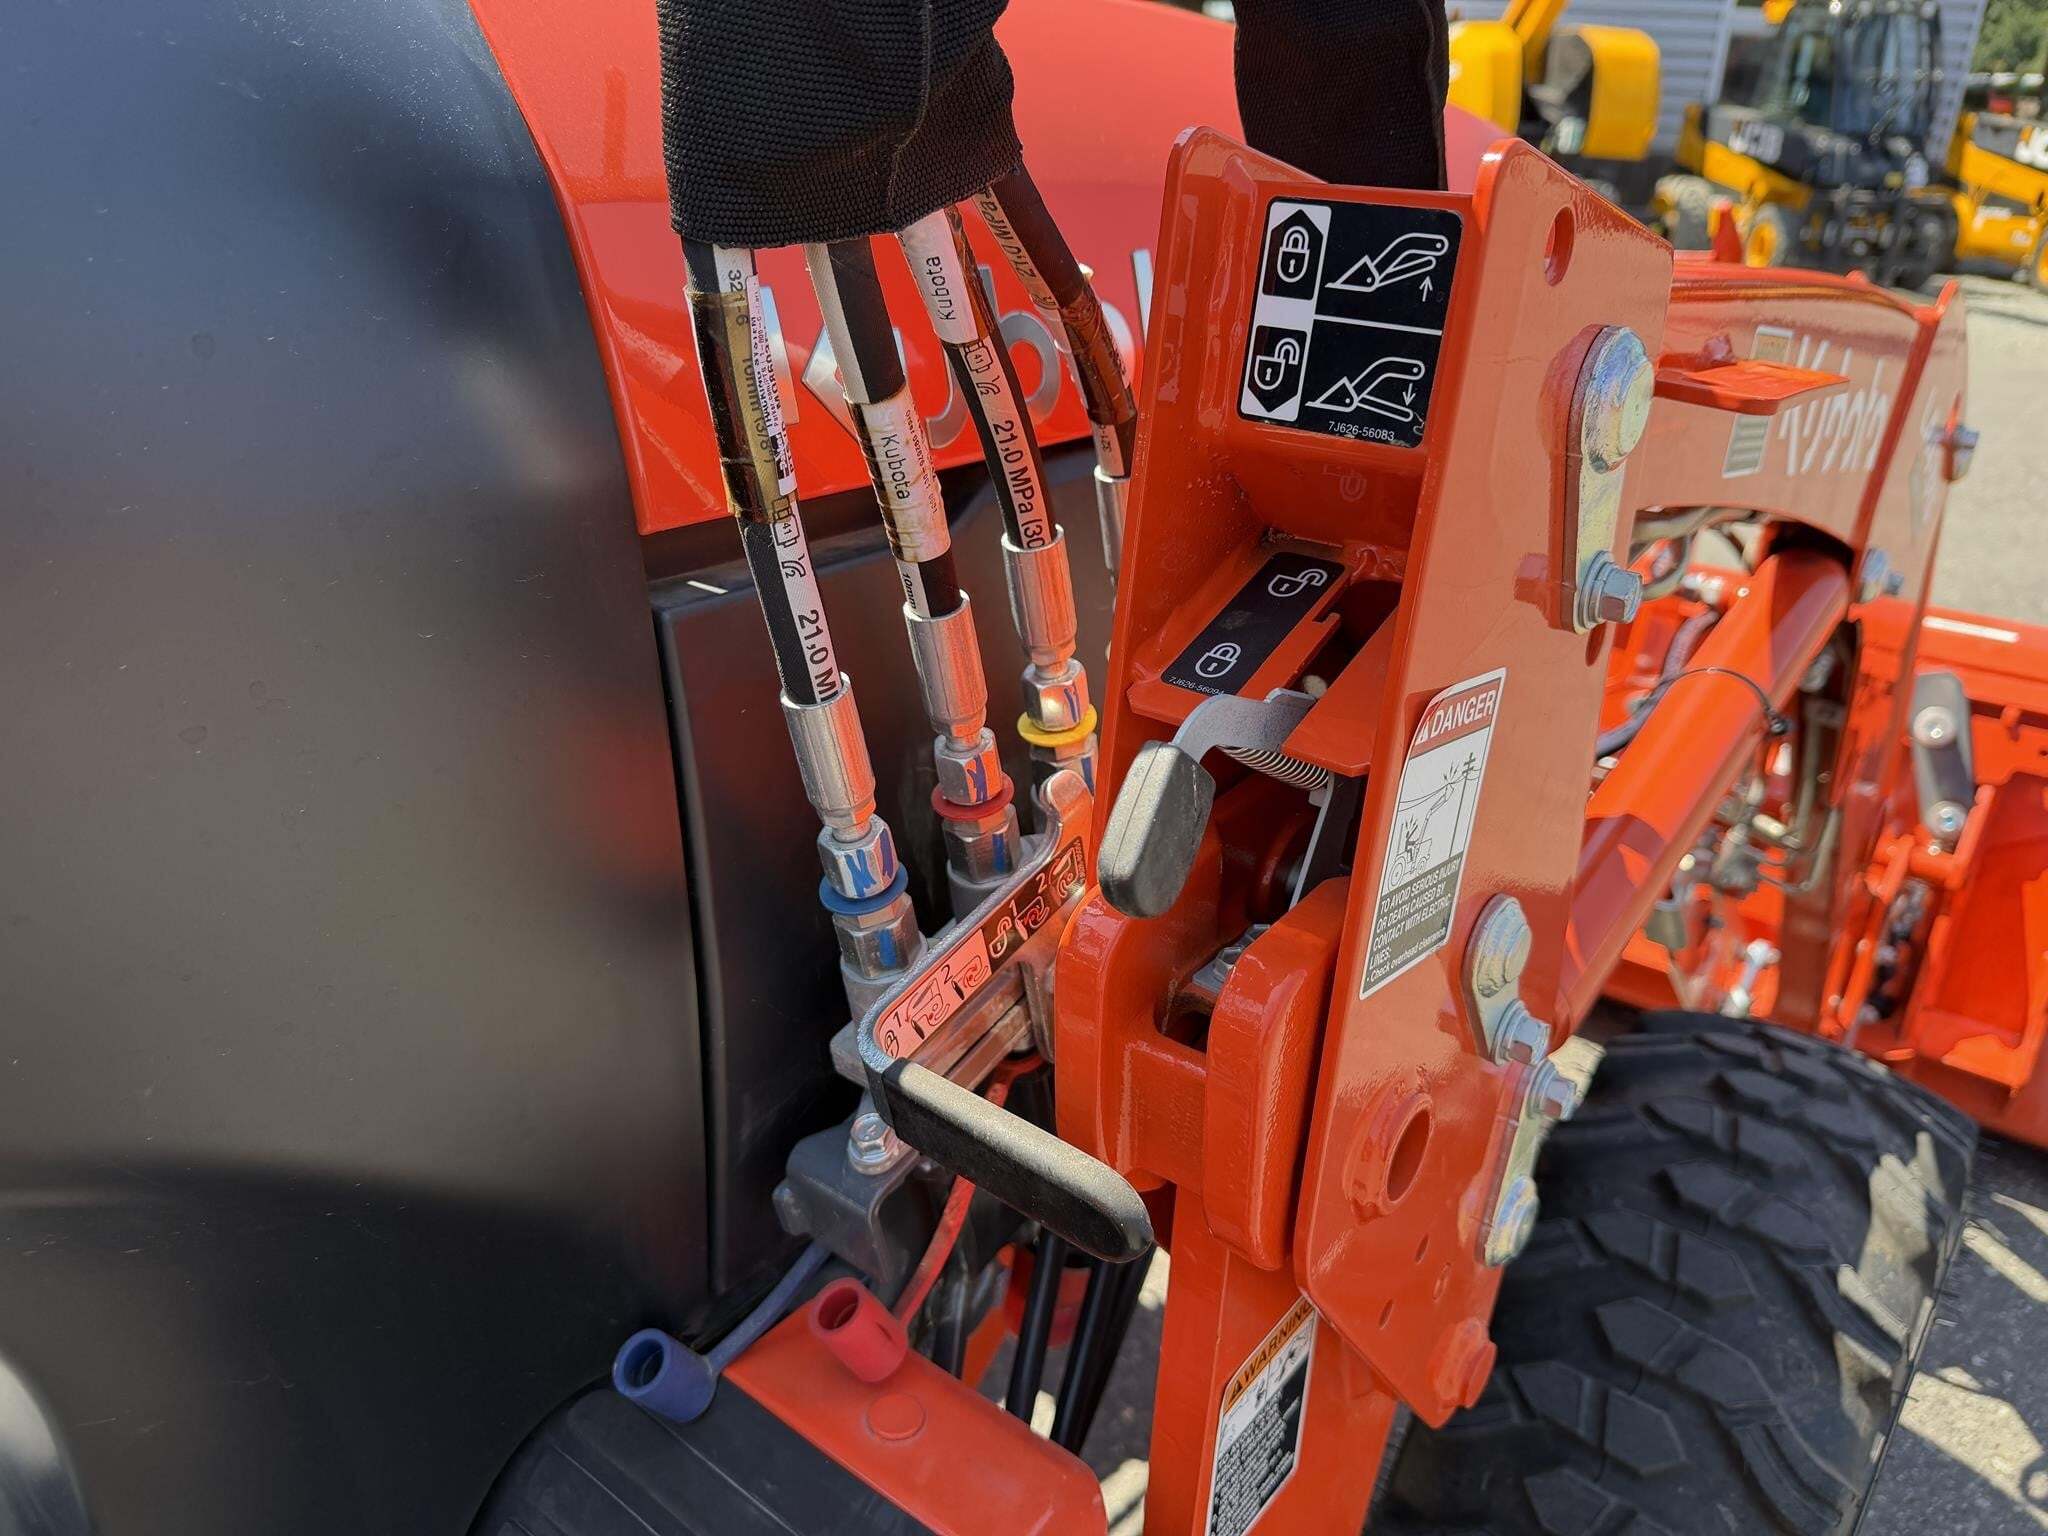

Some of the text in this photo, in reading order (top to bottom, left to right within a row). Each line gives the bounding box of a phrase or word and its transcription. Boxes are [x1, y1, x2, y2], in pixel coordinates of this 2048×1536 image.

[926, 256, 956, 320] Kubota
[881, 434, 912, 500] Kubota
[993, 419, 1023, 465] 21,0
[1008, 466, 1038, 514] MPa
[797, 609, 830, 666] 21,0
[1431, 689, 1497, 738] DANGER
[941, 965, 954, 986] 2
